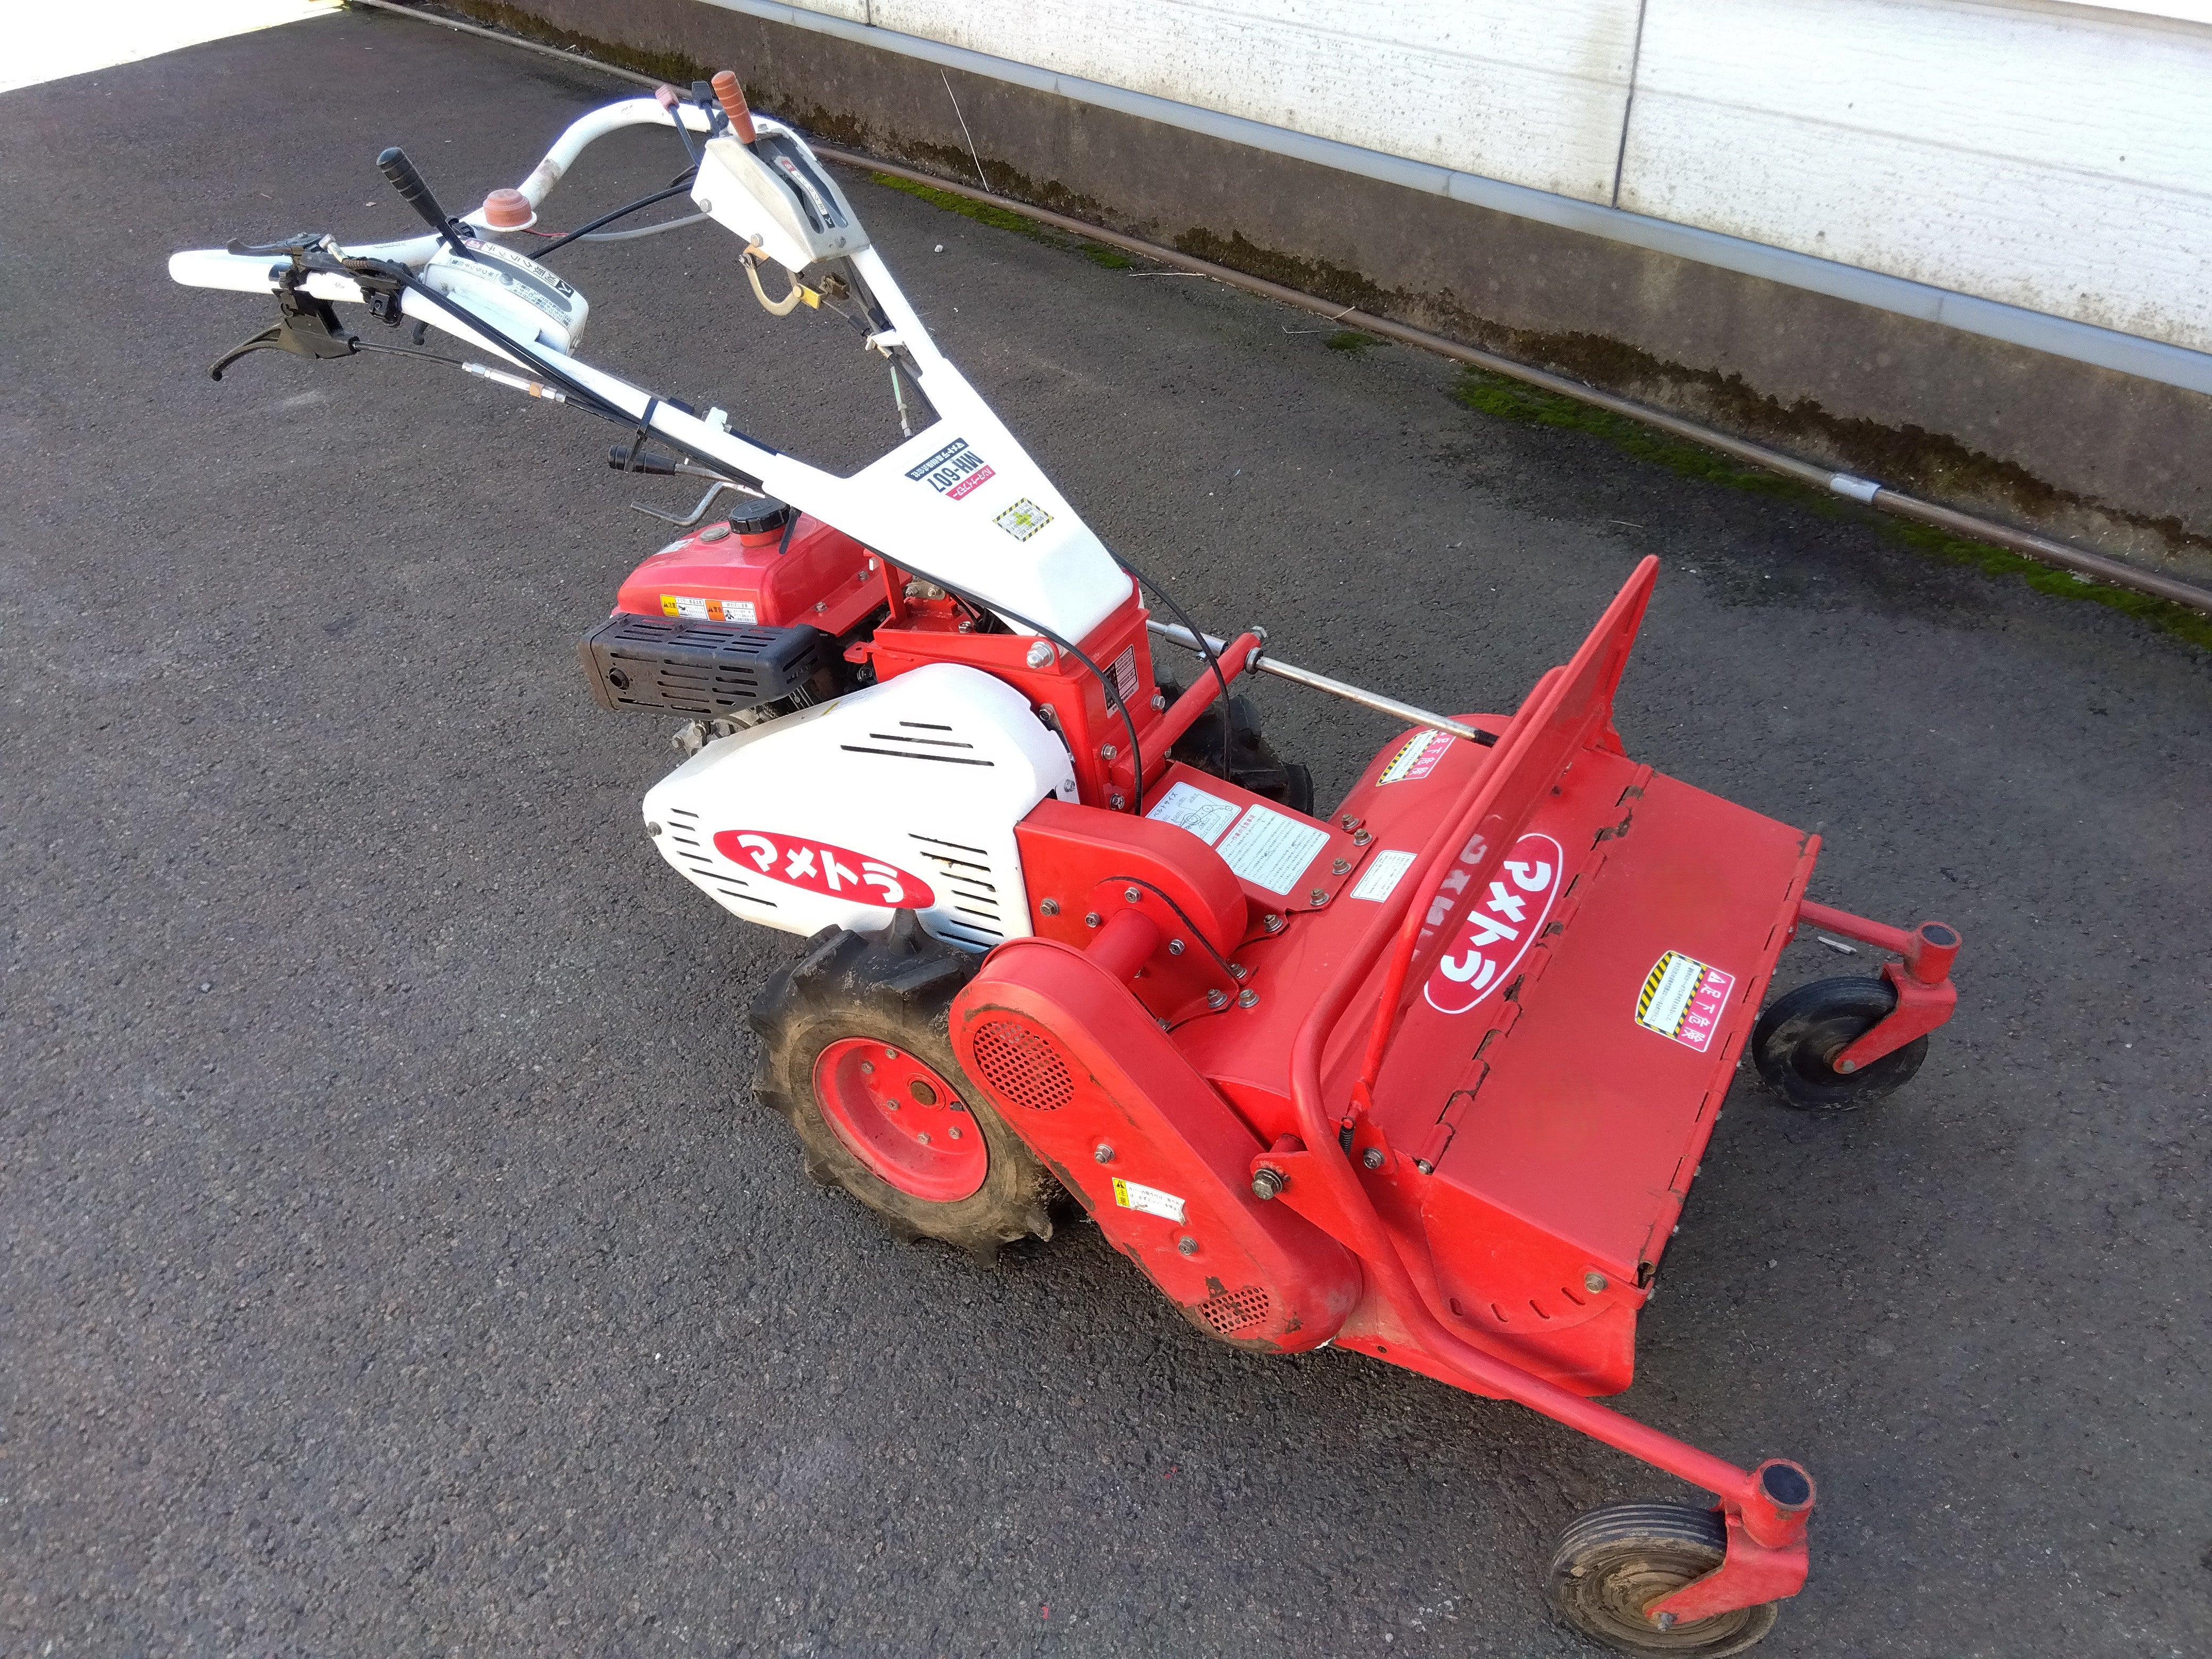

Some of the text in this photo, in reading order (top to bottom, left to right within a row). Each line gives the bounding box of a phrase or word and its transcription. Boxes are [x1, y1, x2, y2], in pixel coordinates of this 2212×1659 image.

[485, 243, 557, 286] 刈取クラッチ
[558, 281, 572, 294] 入
[927, 450, 985, 493] MH-607
[952, 468, 992, 498] ハンマーナイフモアー
[1409, 738, 1450, 776] 足下危険
[1153, 791, 1178, 817] ベルトサイズ
[736, 834, 904, 903] マメトラ
[1440, 860, 1552, 990] マメトラ
[1681, 983, 1722, 1043] 足下危険
[1117, 1188, 1128, 1206] 注意
